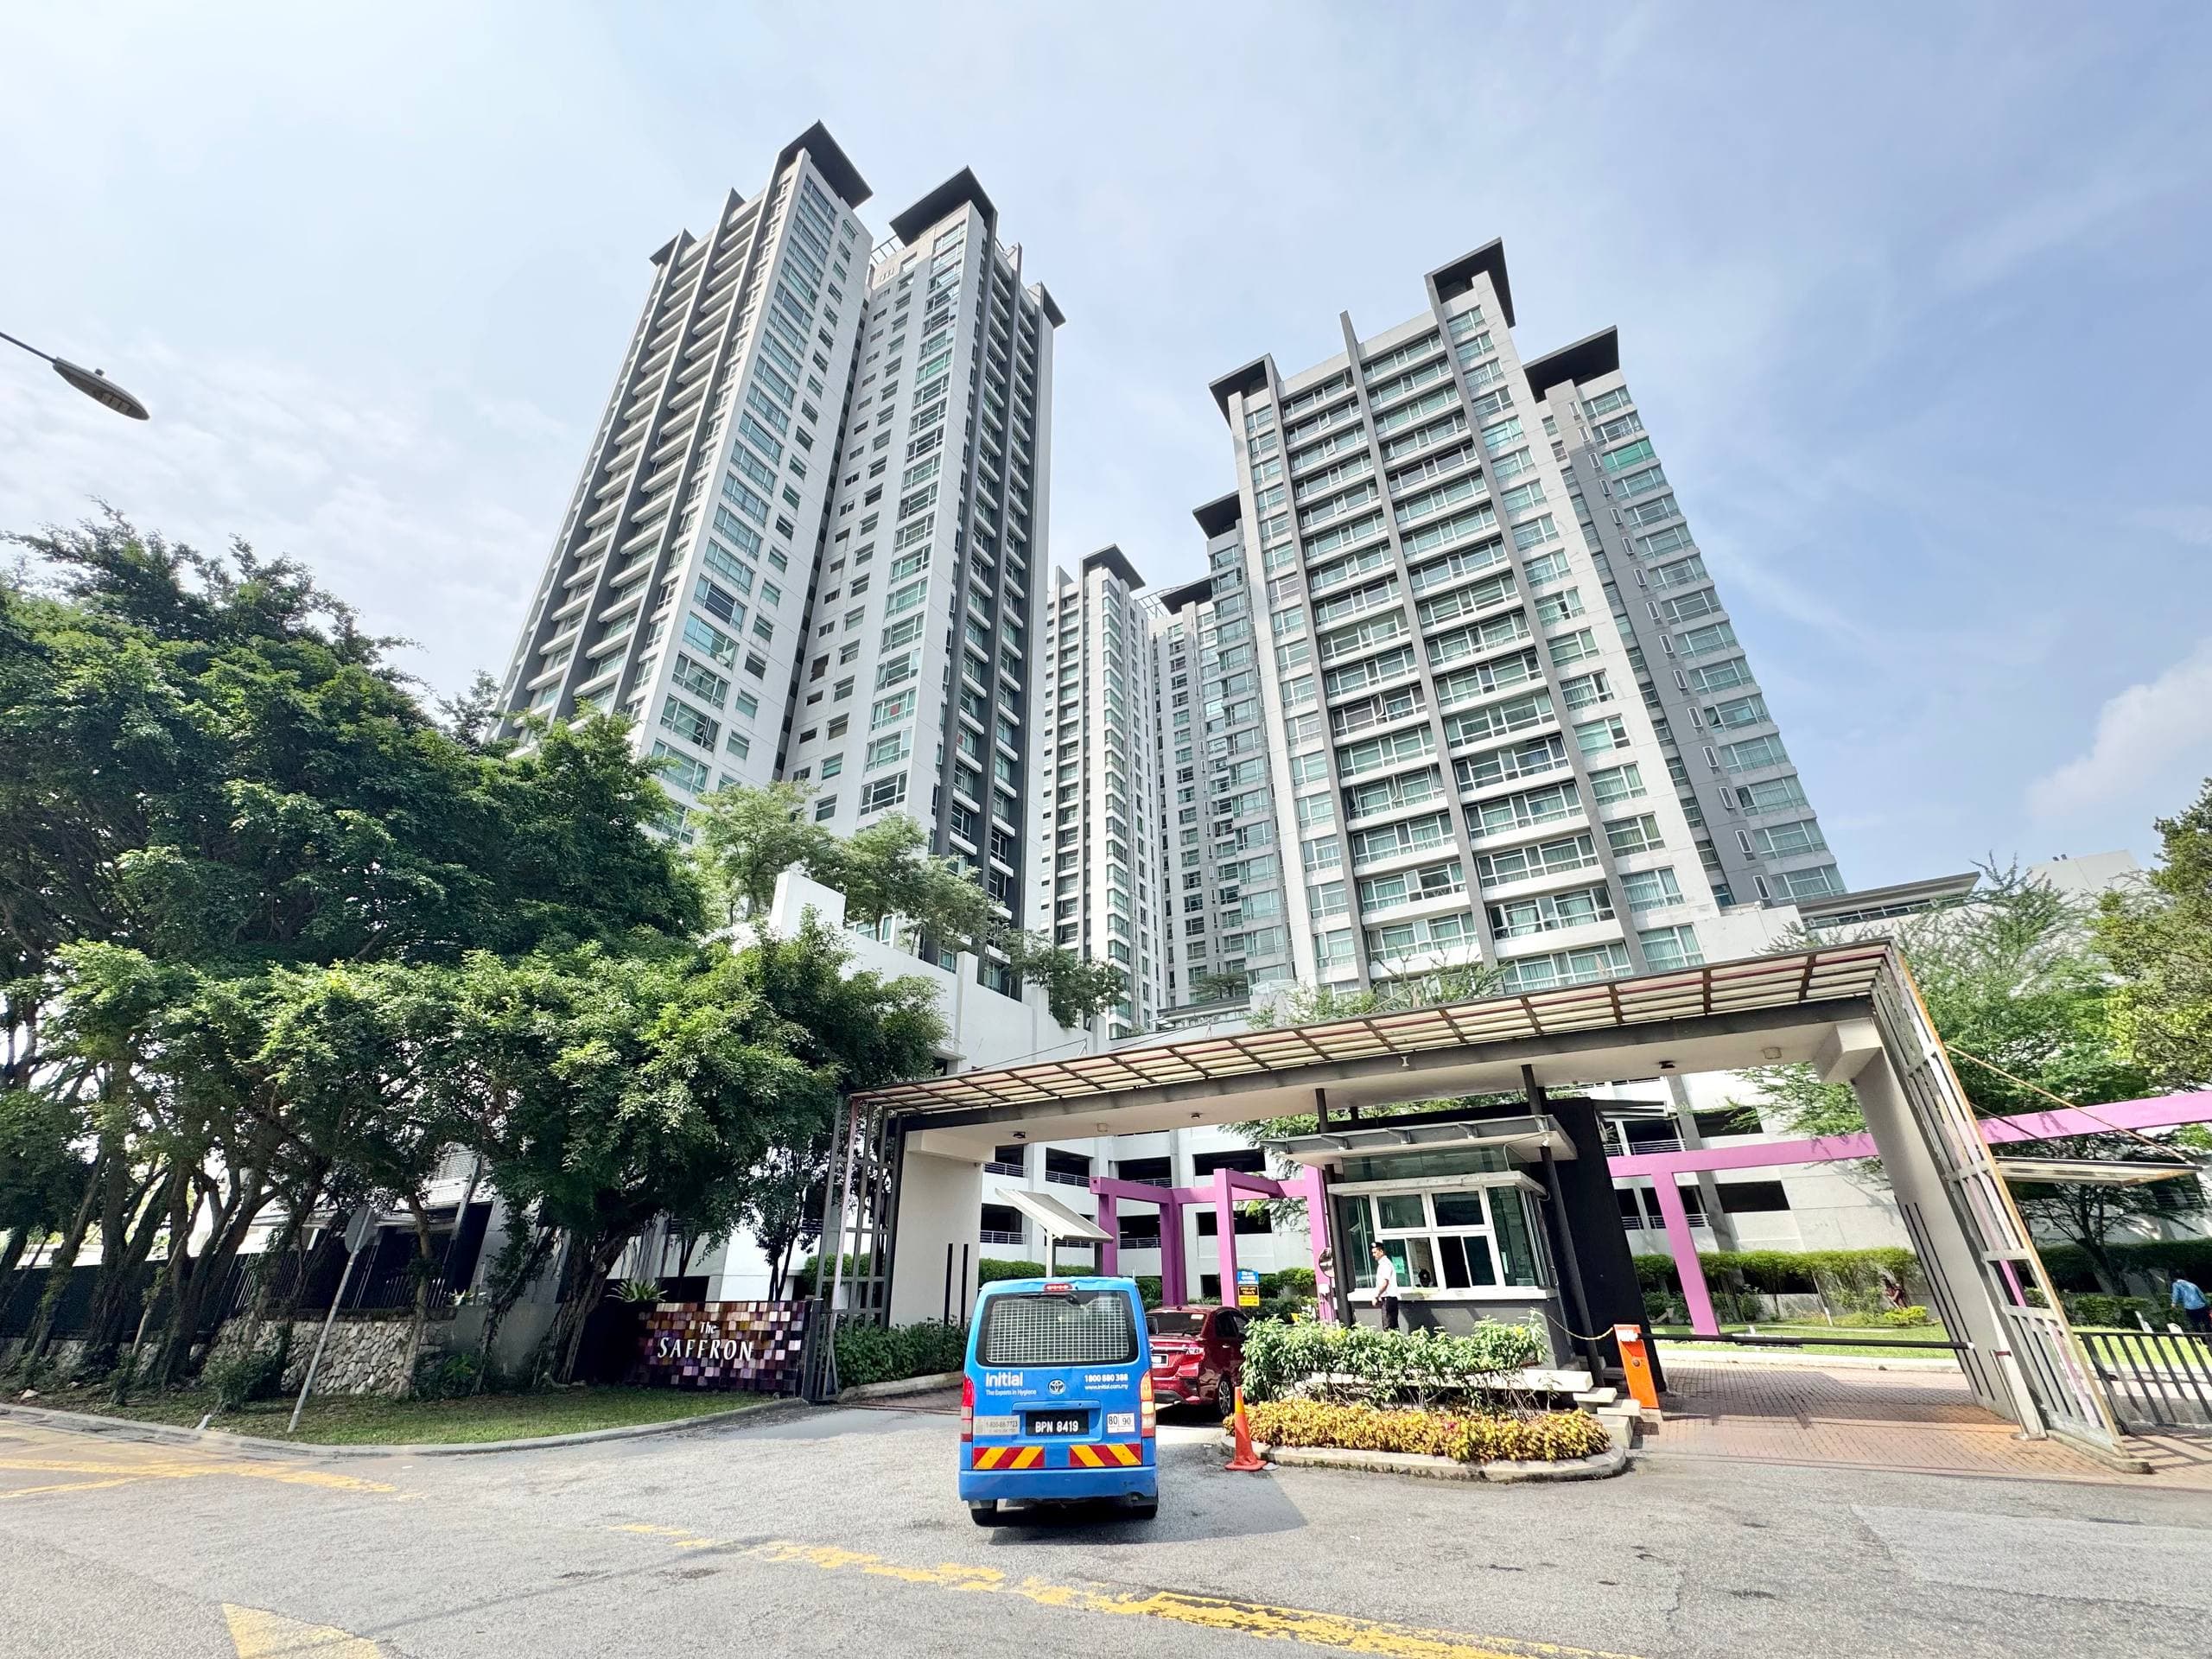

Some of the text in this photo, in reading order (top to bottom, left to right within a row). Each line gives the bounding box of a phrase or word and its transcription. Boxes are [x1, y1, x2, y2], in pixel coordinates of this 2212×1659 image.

[700, 1322, 718, 1334] The
[658, 1337, 753, 1361] SAFFRON
[1084, 1374, 1102, 1382] 1800
[1108, 1415, 1118, 1425] 80
[1035, 1420, 1079, 1433] BPN 8419
